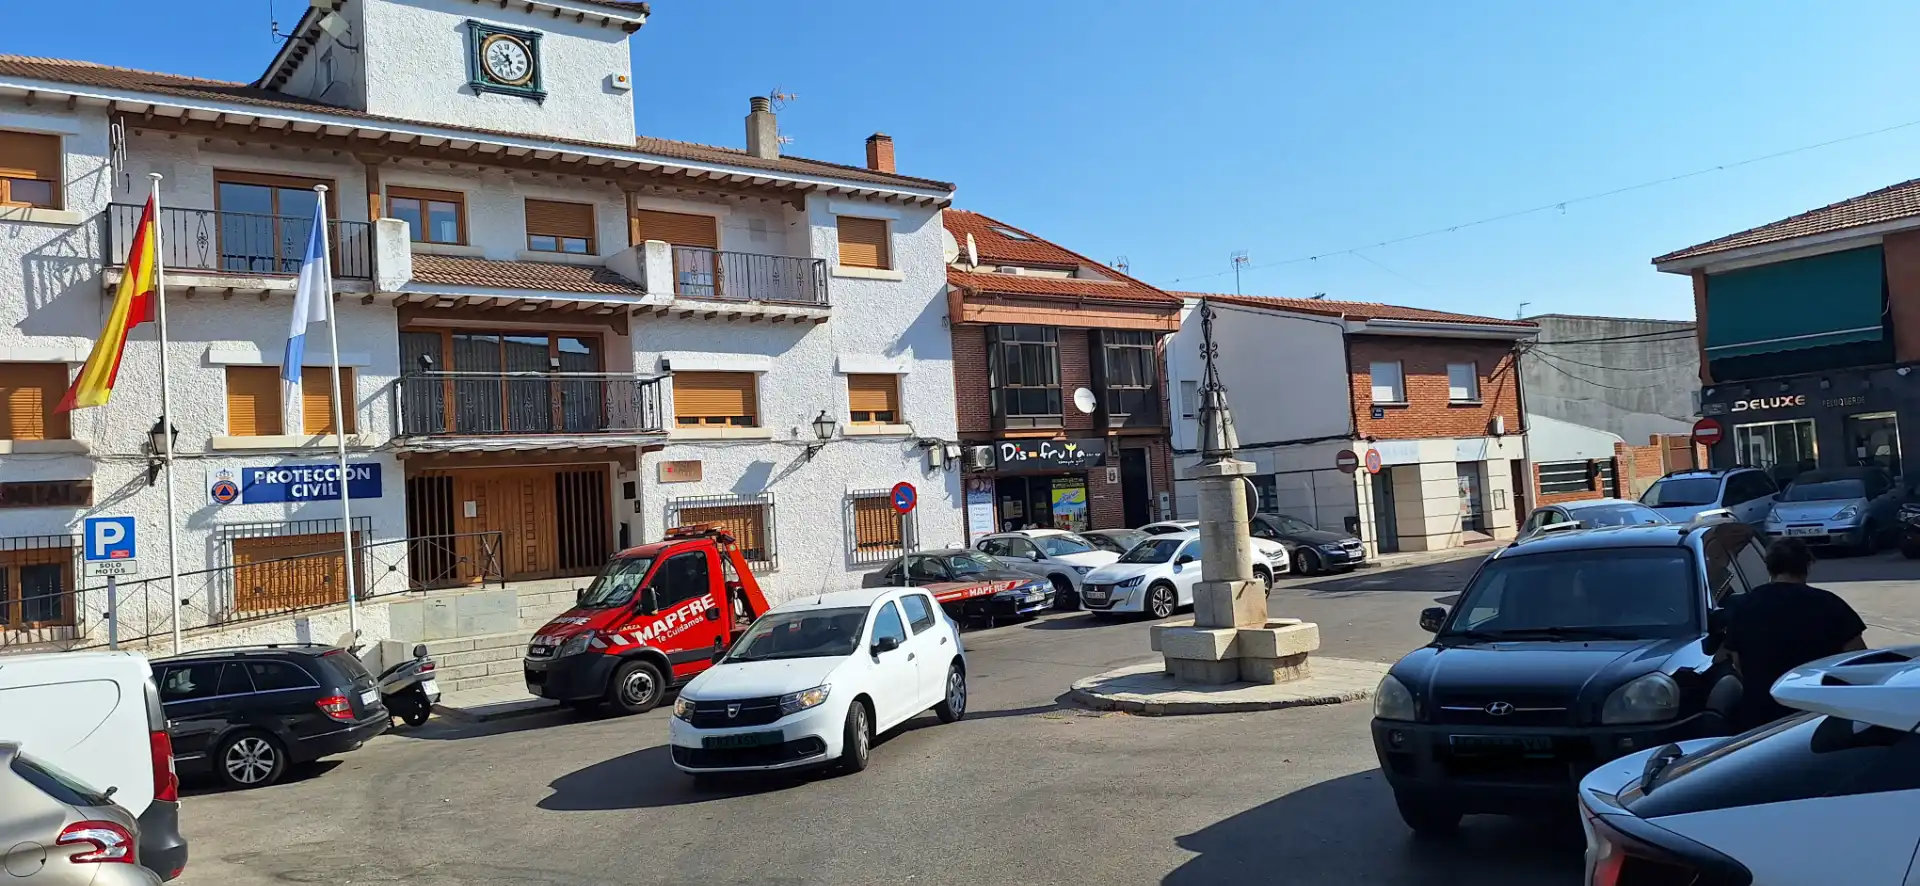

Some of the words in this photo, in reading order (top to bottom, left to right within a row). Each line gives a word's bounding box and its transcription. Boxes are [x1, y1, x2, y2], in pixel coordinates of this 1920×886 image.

[1731, 395, 1806, 412] DELUXE
[254, 464, 371, 484] PROTECCIÓN
[291, 482, 338, 498] CIVIL
[96, 522, 125, 555] P
[95, 567, 126, 575] MOTOS
[969, 584, 1006, 597] MAPFRE
[634, 593, 715, 645] MAPFRE
[656, 633, 667, 643] Te
[666, 615, 704, 638] Cuidamos
